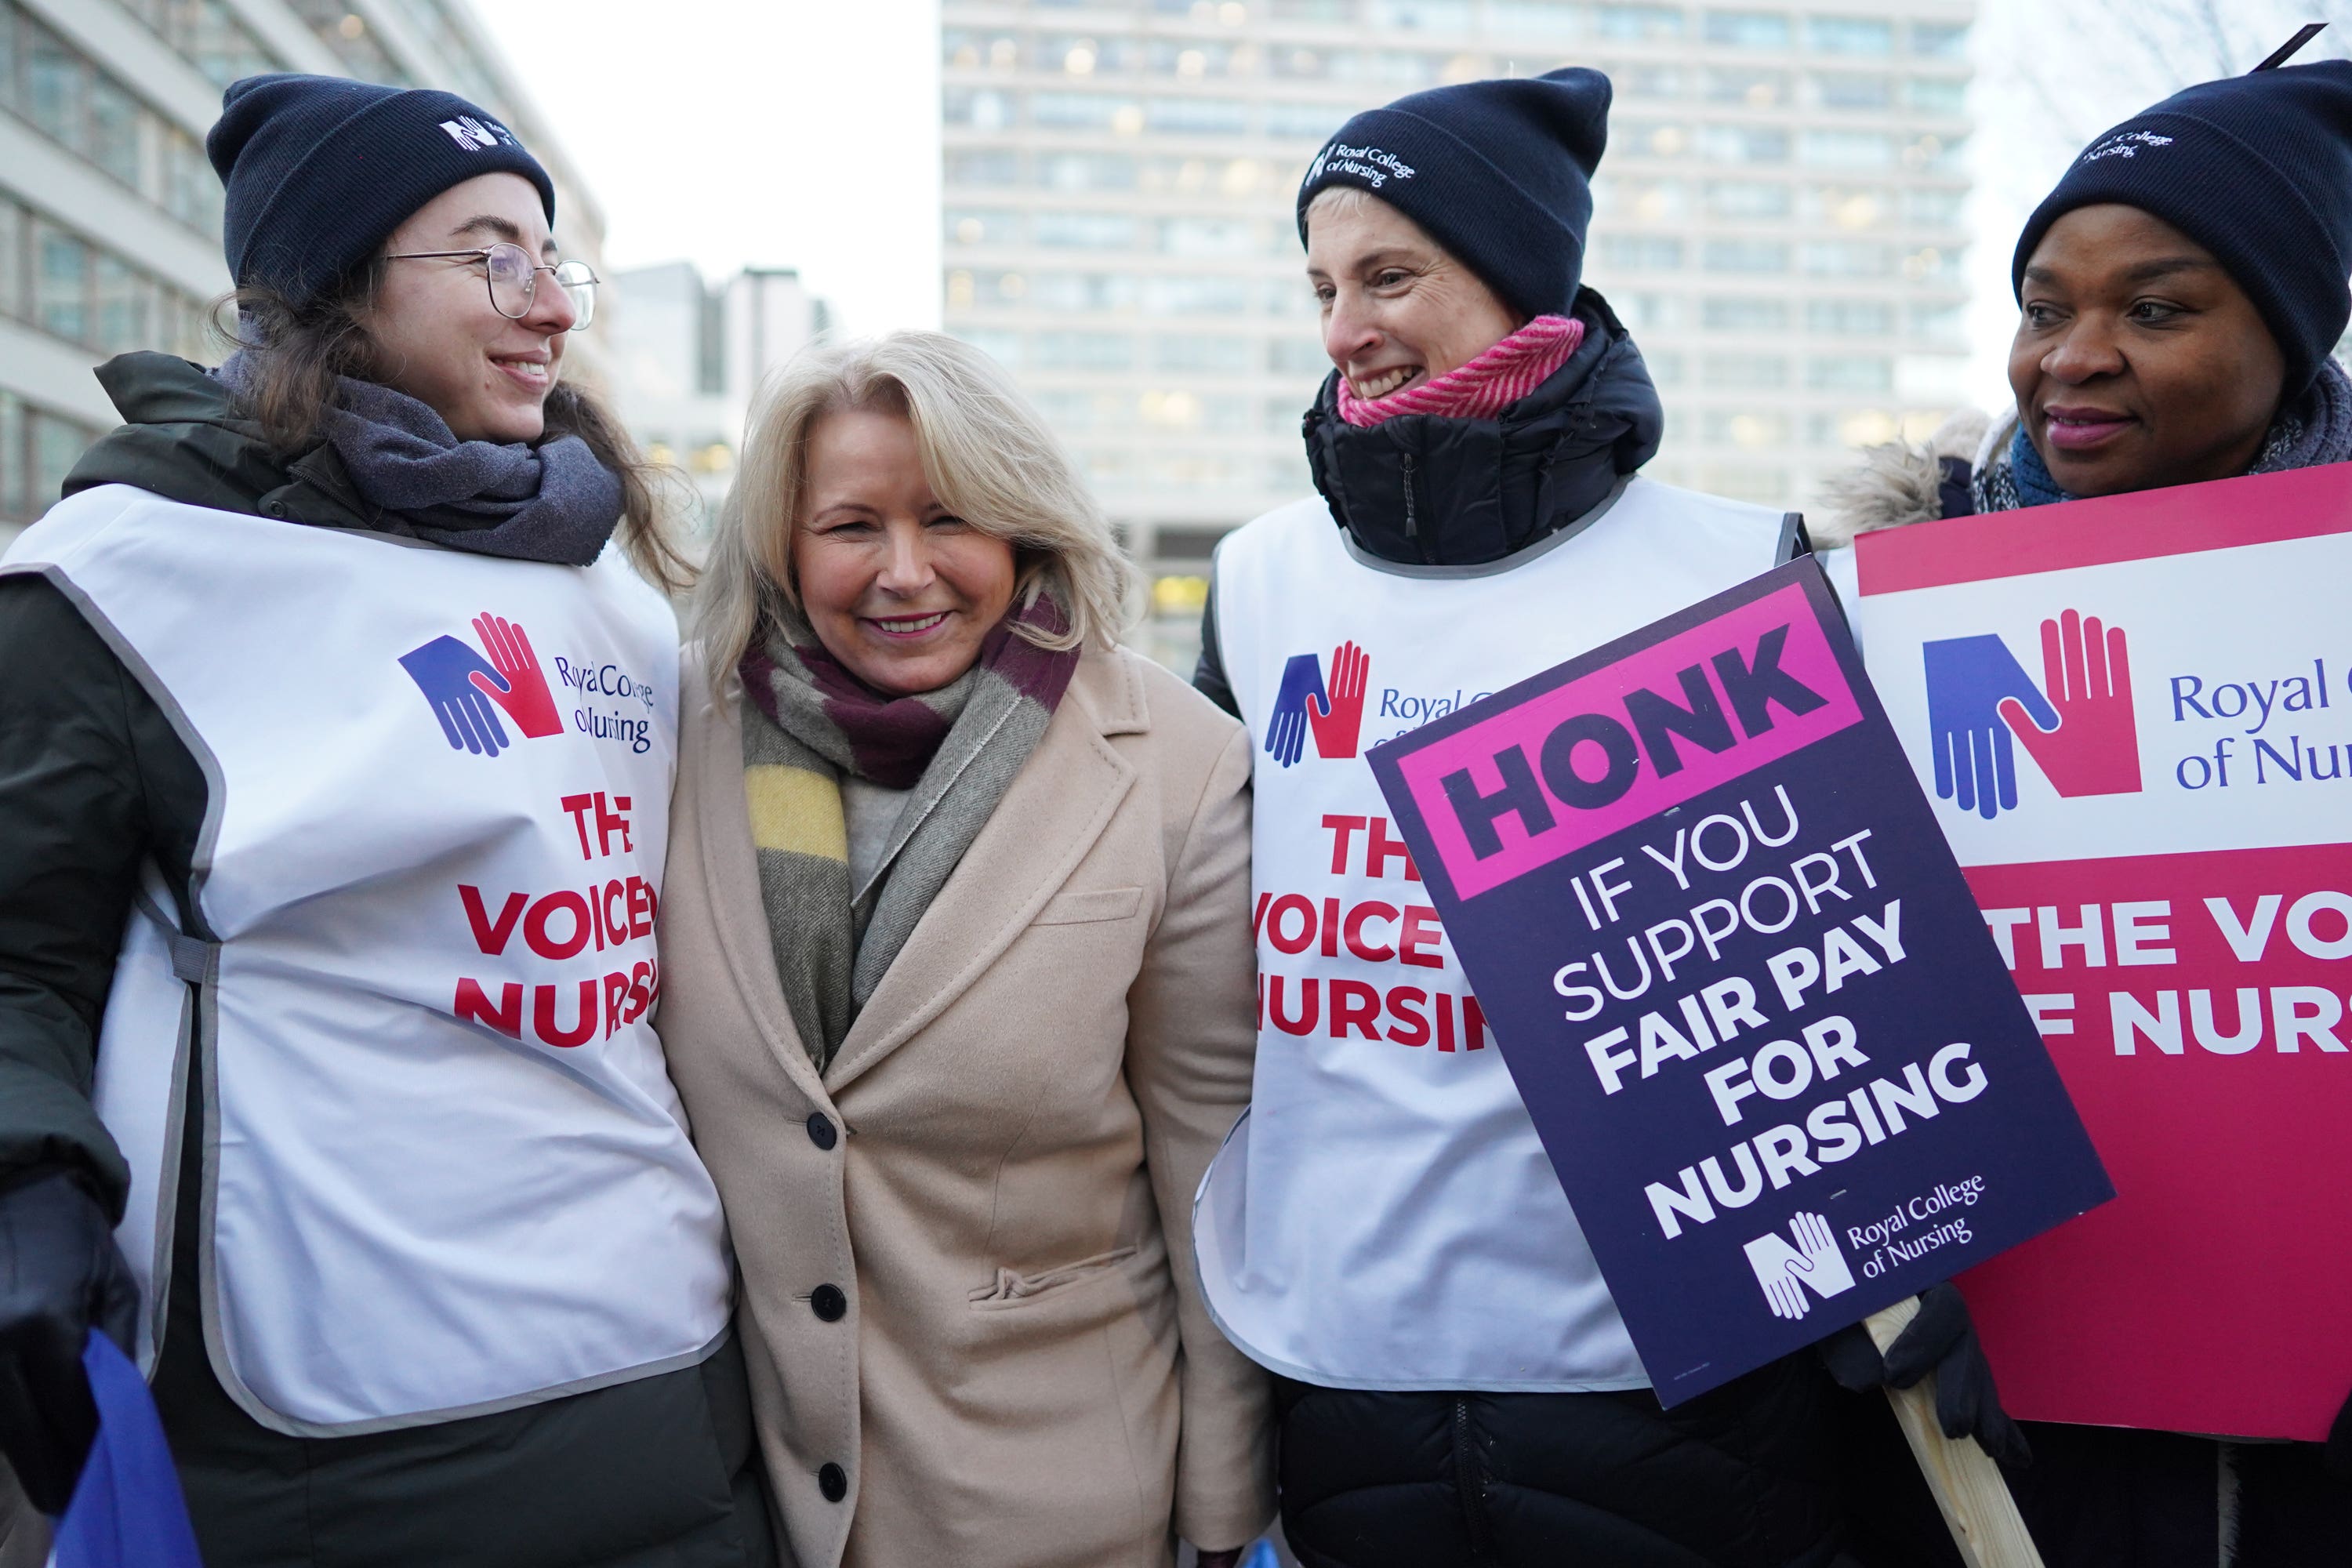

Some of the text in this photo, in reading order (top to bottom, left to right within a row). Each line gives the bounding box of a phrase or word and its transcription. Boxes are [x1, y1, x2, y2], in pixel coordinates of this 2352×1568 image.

[1327, 159, 1387, 187] of Nursing
[1336, 144, 1415, 178] Royal College
[2170, 659, 2329, 734] Royal
[1440, 623, 1829, 861] HONK
[2176, 738, 2234, 789] of
[1322, 814, 1421, 881] TH
[1570, 784, 1799, 931] IF YOU
[457, 876, 652, 960] VOICE
[1553, 828, 1877, 1021] SUPPORT
[1980, 900, 2176, 970] THE
[1584, 898, 1907, 1095] FAIR PAY
[2020, 985, 2352, 1055] F NUR
[1704, 1015, 1871, 1127] FOR
[1644, 1043, 1988, 1240] NURSING
[1847, 1175, 1985, 1250] Royal College
[1863, 1218, 1973, 1278] of Nursing
